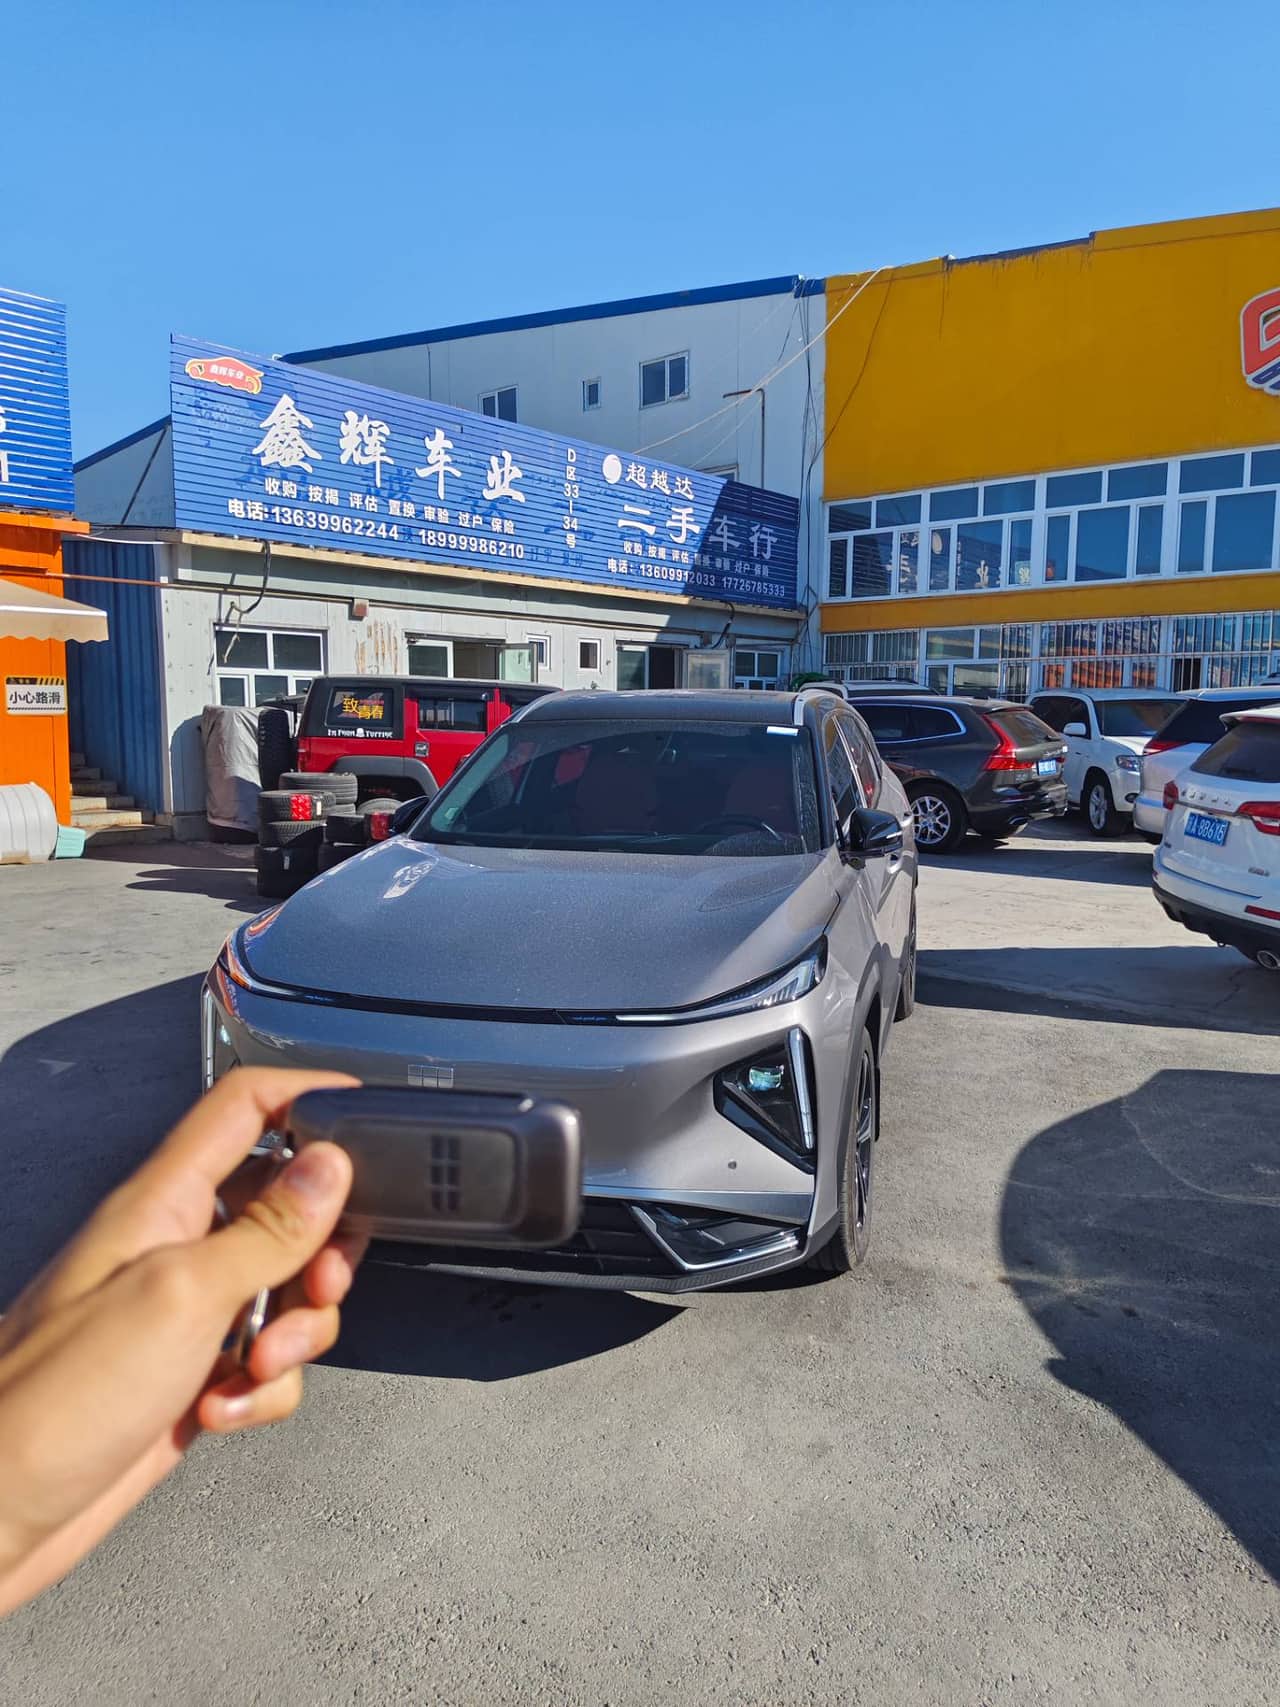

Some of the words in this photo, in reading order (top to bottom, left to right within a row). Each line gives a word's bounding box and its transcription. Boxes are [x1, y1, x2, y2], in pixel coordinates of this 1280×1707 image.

[252, 393, 526, 503] 鑫辉车业
[625, 462, 695, 500] 超越达
[264, 477, 297, 499] 收购
[308, 484, 339, 506] 按揭
[349, 492, 378, 513] 评估
[388, 499, 416, 519] 置换
[423, 506, 449, 524] 审验
[458, 511, 483, 529] 过户
[491, 517, 515, 535] 保险
[418, 528, 524, 559] 18999986210
[617, 504, 778, 560] 二手车行
[640, 563, 716, 587] 13609912033
[721, 576, 785, 597] 17726785333
[9, 691, 60, 704] 小心路滑
